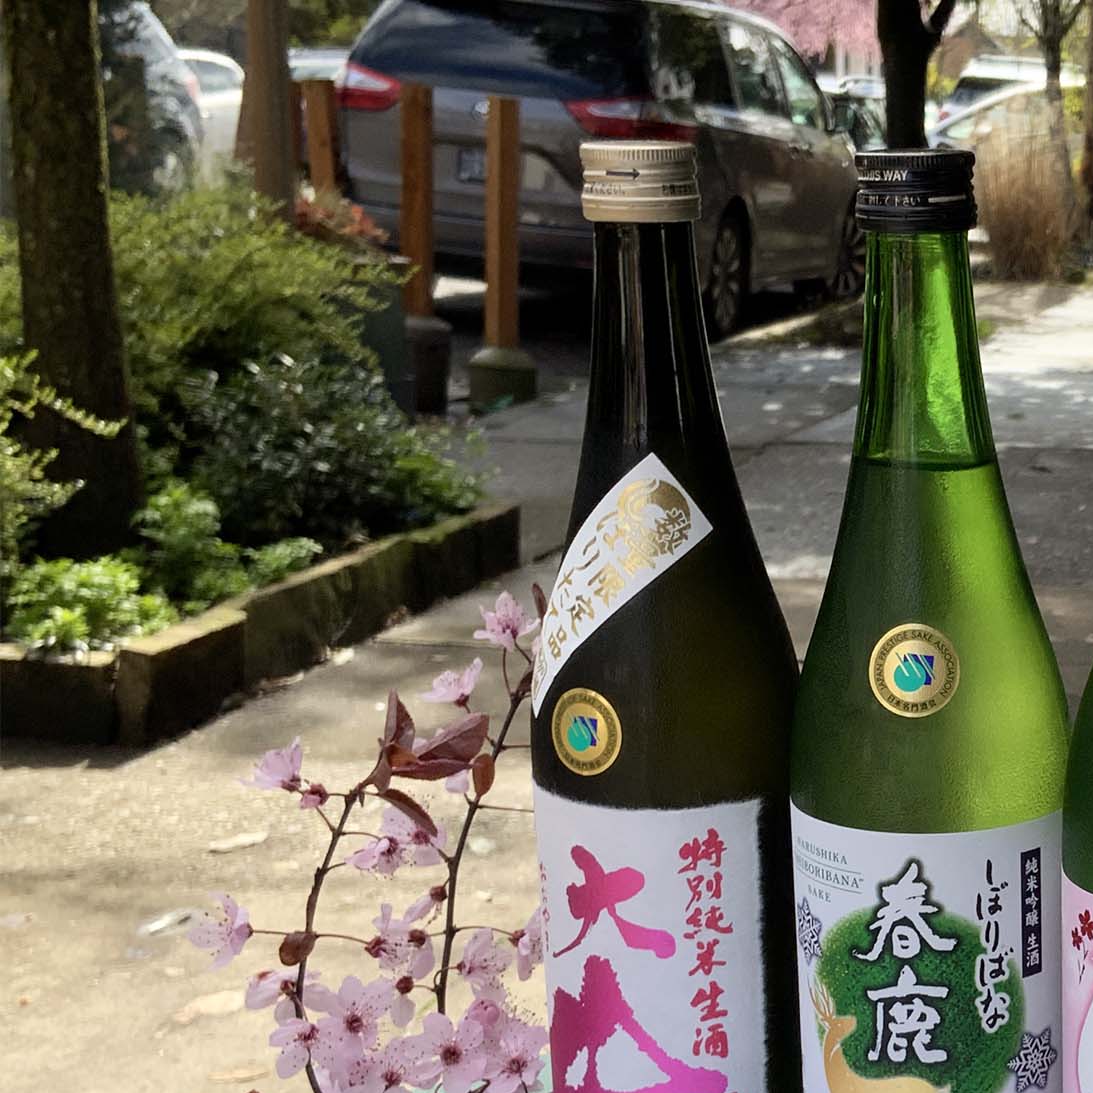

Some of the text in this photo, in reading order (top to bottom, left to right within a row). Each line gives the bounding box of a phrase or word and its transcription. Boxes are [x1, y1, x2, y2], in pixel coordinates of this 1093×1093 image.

[883, 169, 909, 181] WAY
[911, 631, 933, 642] SAKE
[934, 640, 956, 697] ASSOCIATION
[807, 884, 832, 903] SAKE
[852, 862, 958, 1063] 春鹿
[1026, 933, 1040, 967] 生酒
